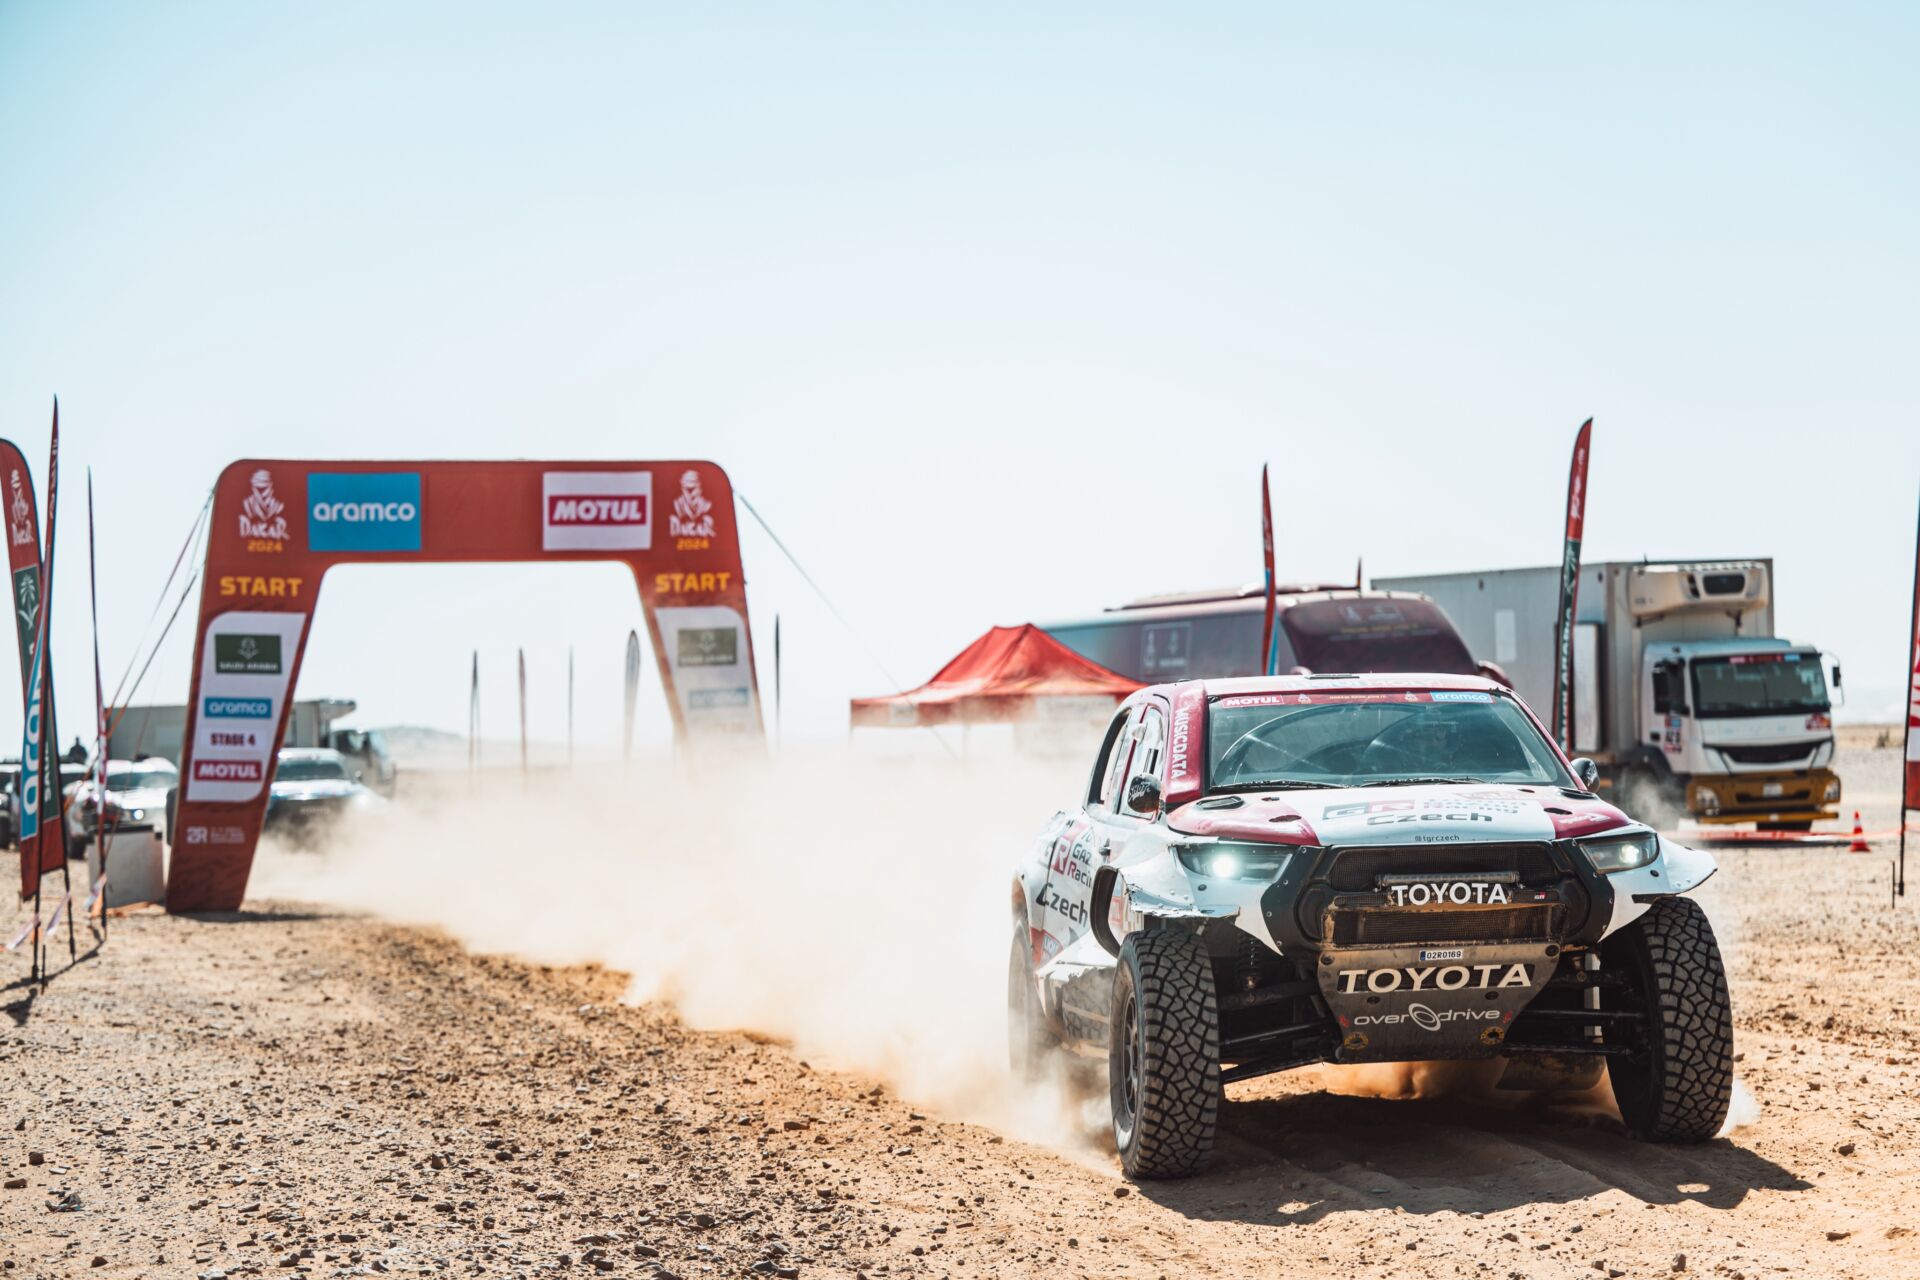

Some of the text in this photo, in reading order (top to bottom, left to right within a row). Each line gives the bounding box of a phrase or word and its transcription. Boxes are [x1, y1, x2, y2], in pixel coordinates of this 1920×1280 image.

[313, 502, 416, 521] aramco
[553, 500, 642, 521] MOTUL
[247, 539, 283, 552] 2024
[677, 538, 709, 551] 2024
[220, 576, 302, 597] START
[655, 572, 731, 593] START
[1226, 695, 1280, 706] MOTUL
[1435, 692, 1488, 701] aramco
[209, 702, 267, 715] aramco
[248, 733, 256, 746] 4
[1171, 706, 1189, 780] MUSICDATA
[198, 764, 258, 778] MOTUL
[1367, 812, 1493, 826] Czech
[1415, 834, 1460, 842] @tgrczech
[1391, 882, 1508, 907] TOYOTA
[1036, 882, 1089, 928] Czech
[1339, 963, 1532, 995] TOYOTA
